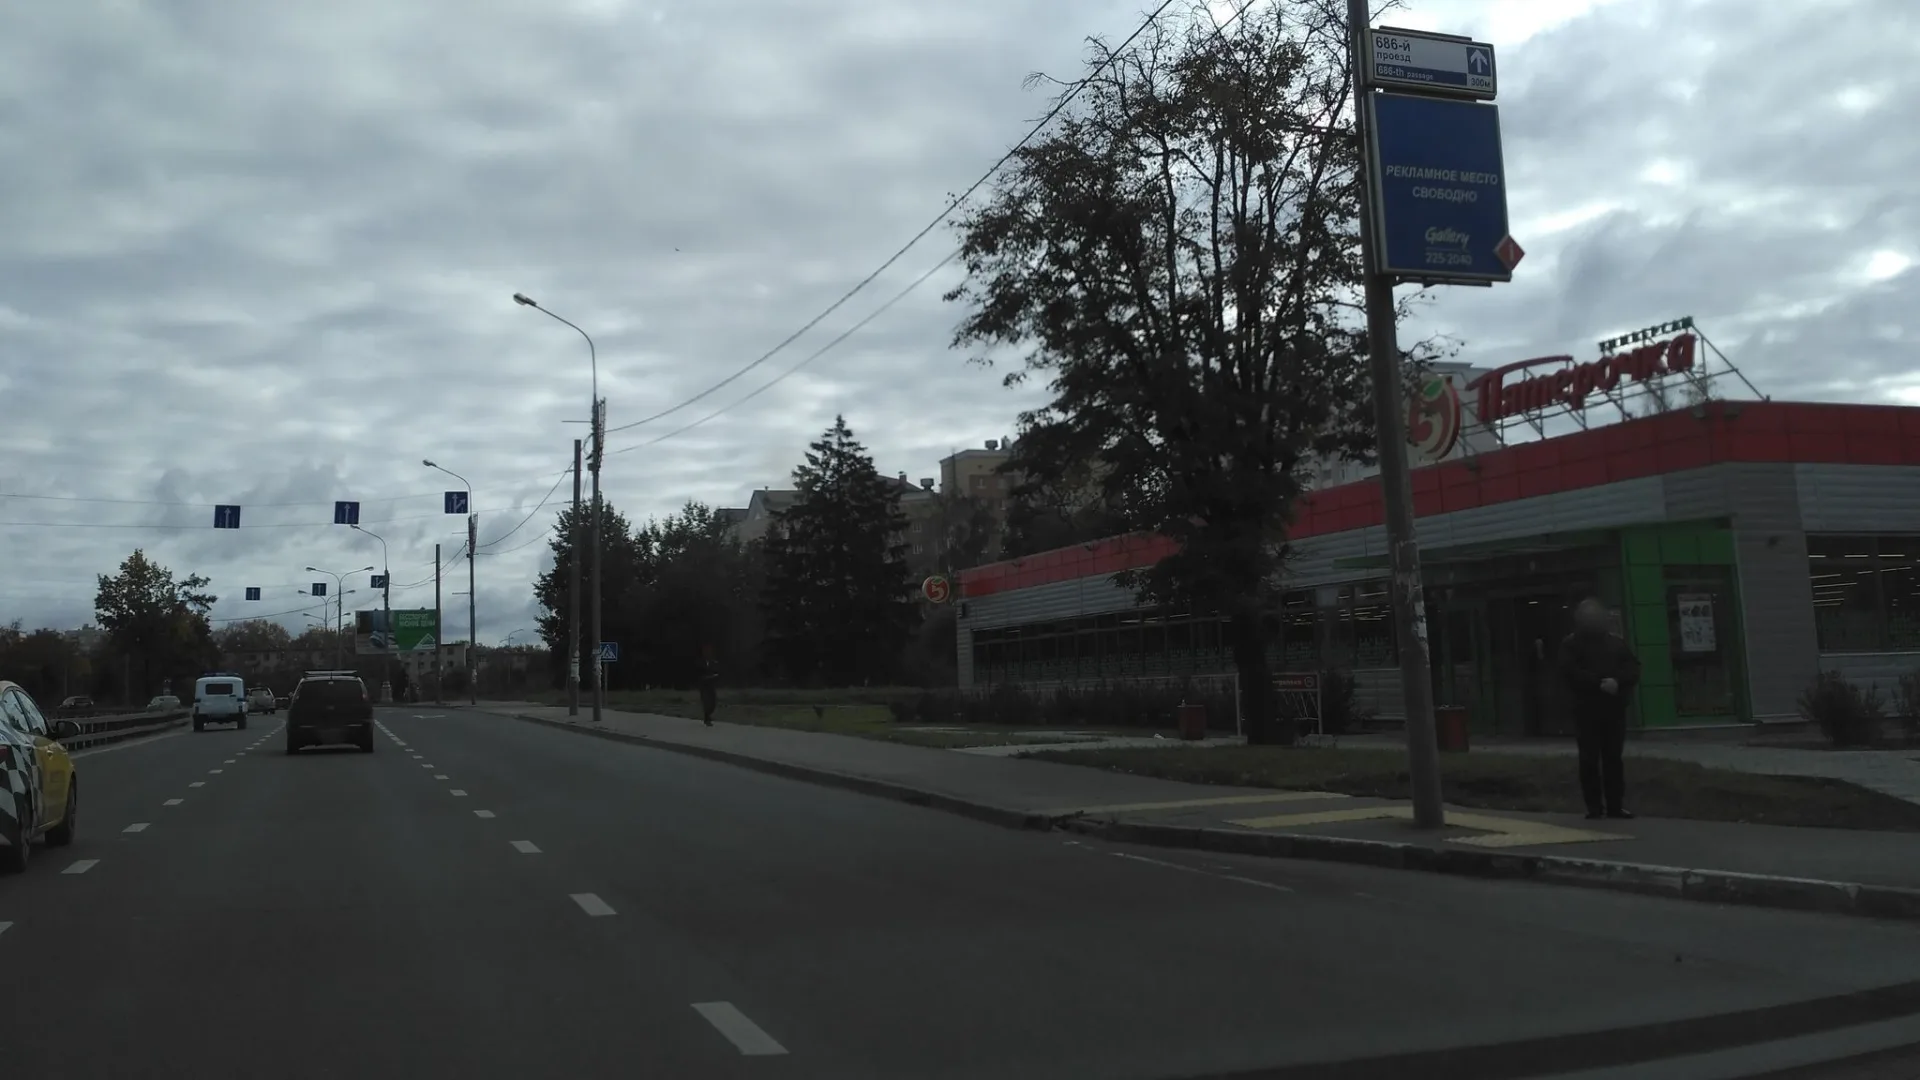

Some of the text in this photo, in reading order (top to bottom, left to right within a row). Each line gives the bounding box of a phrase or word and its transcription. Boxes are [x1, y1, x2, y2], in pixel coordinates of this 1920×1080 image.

[1376, 36, 1411, 52] 686-й
[1377, 50, 1412, 63] проезд
[1378, 65, 1434, 81] 686-th passage
[1471, 77, 1491, 87] 300м
[1386, 165, 1498, 185] РЕКЛАМНОЕ МЕСТО
[1412, 186, 1478, 203] СВОБОДНО
[1425, 226, 1470, 249] Gallery
